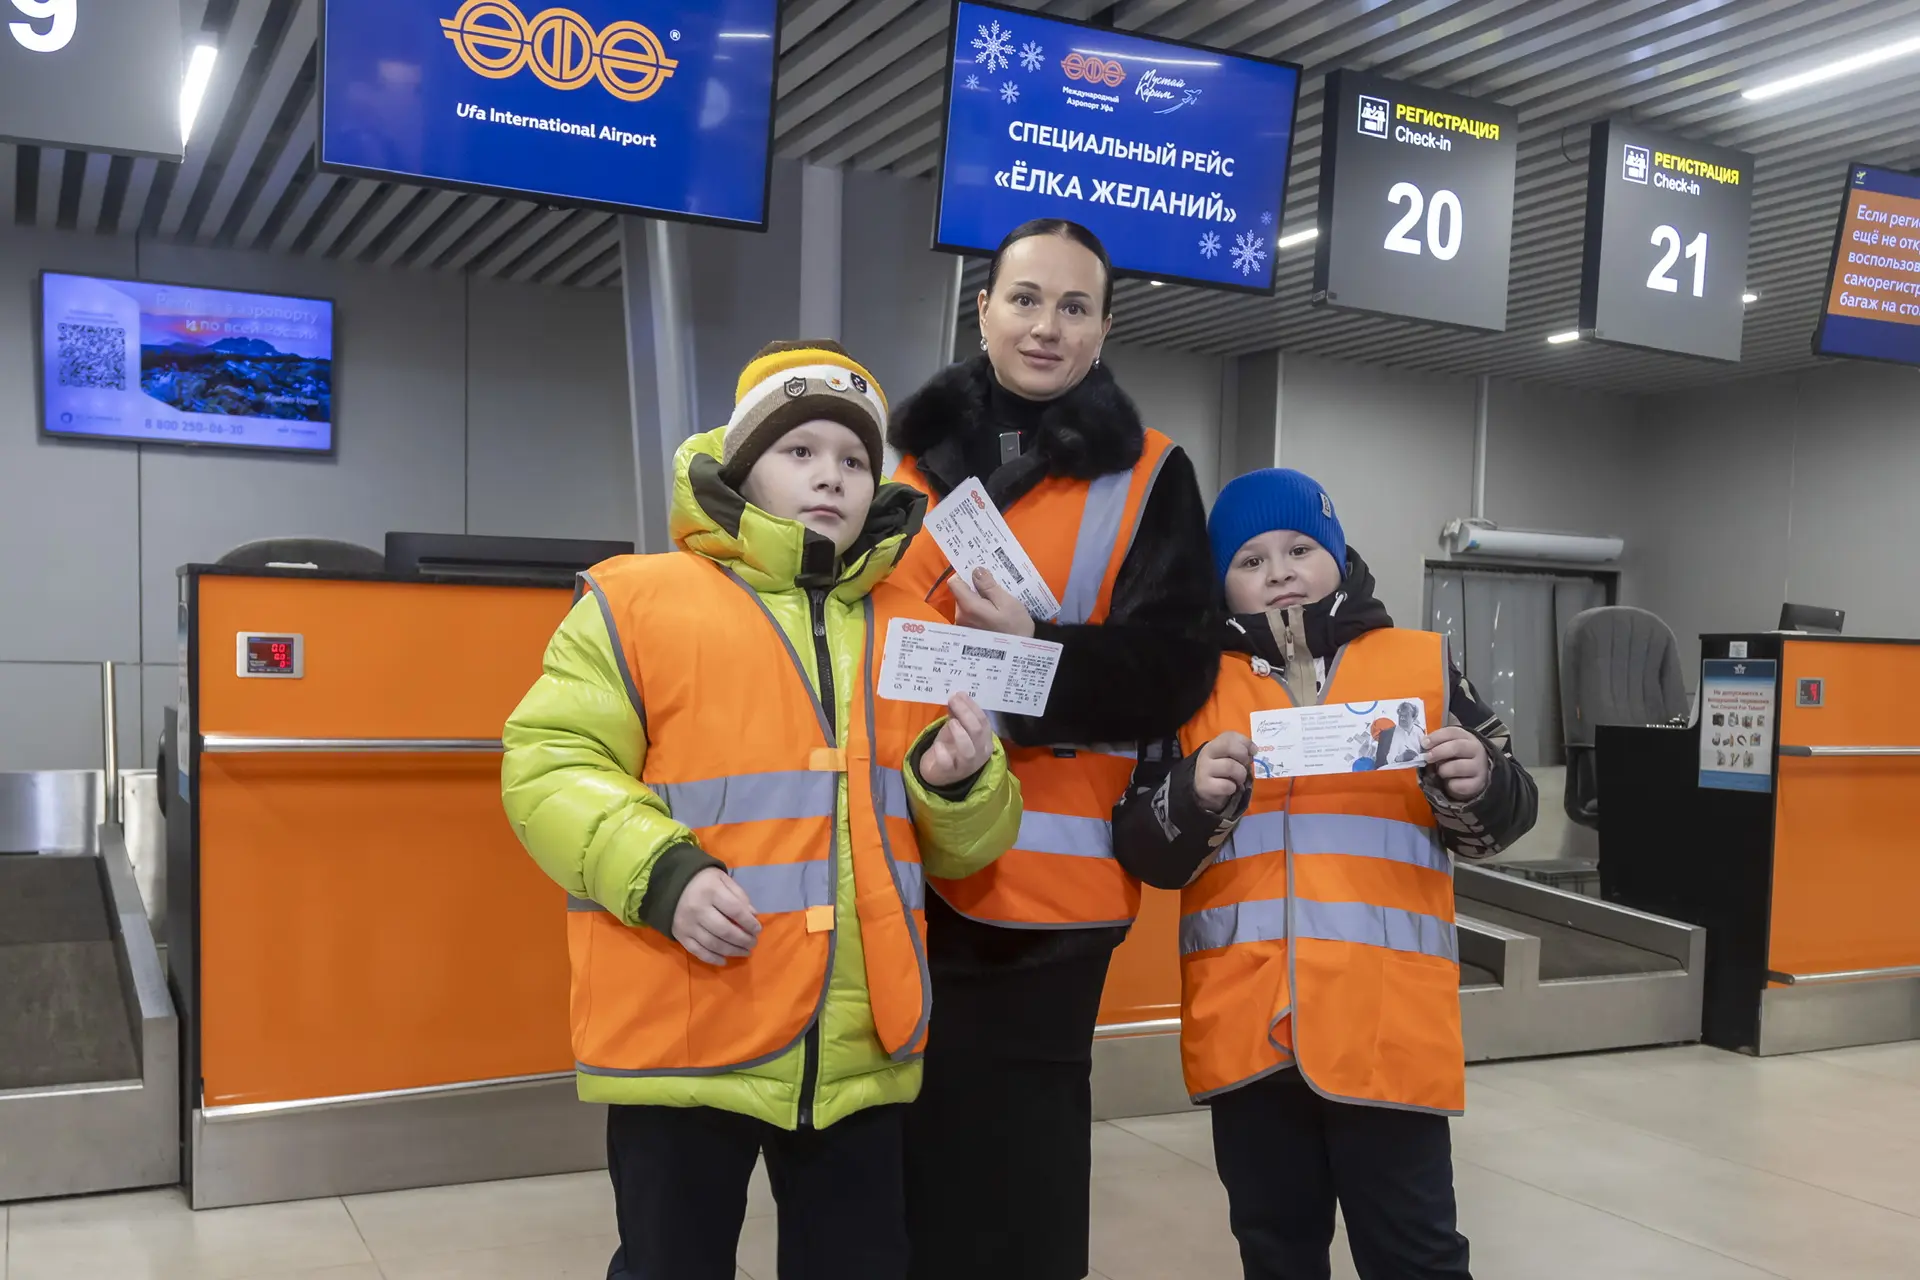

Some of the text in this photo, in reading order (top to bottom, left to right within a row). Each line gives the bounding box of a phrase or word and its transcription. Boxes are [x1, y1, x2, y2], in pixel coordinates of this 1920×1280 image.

[1062, 86, 1120, 103] Международный
[1066, 97, 1114, 113] Аэропорт Уфа
[456, 102, 657, 147] Ufa International Airport
[1396, 104, 1500, 140] РЕГИСТРАЦИЯ
[1008, 121, 1235, 178] СПЕЦИАЛЬНЫЙ РЕЙС
[1395, 126, 1452, 151] Check-in
[1654, 152, 1740, 185] РЕГИСТРАЦИЯ
[994, 160, 1238, 224] «ЁЛКА ЖЕЛАНИЙ»
[1653, 172, 1700, 195] Check-in
[1383, 182, 1463, 261] 20
[1857, 204, 1887, 224] Если
[1852, 229, 1920, 255] ещё не отк
[1646, 224, 1708, 298] 21
[1840, 291, 1920, 317] багаж на сто
